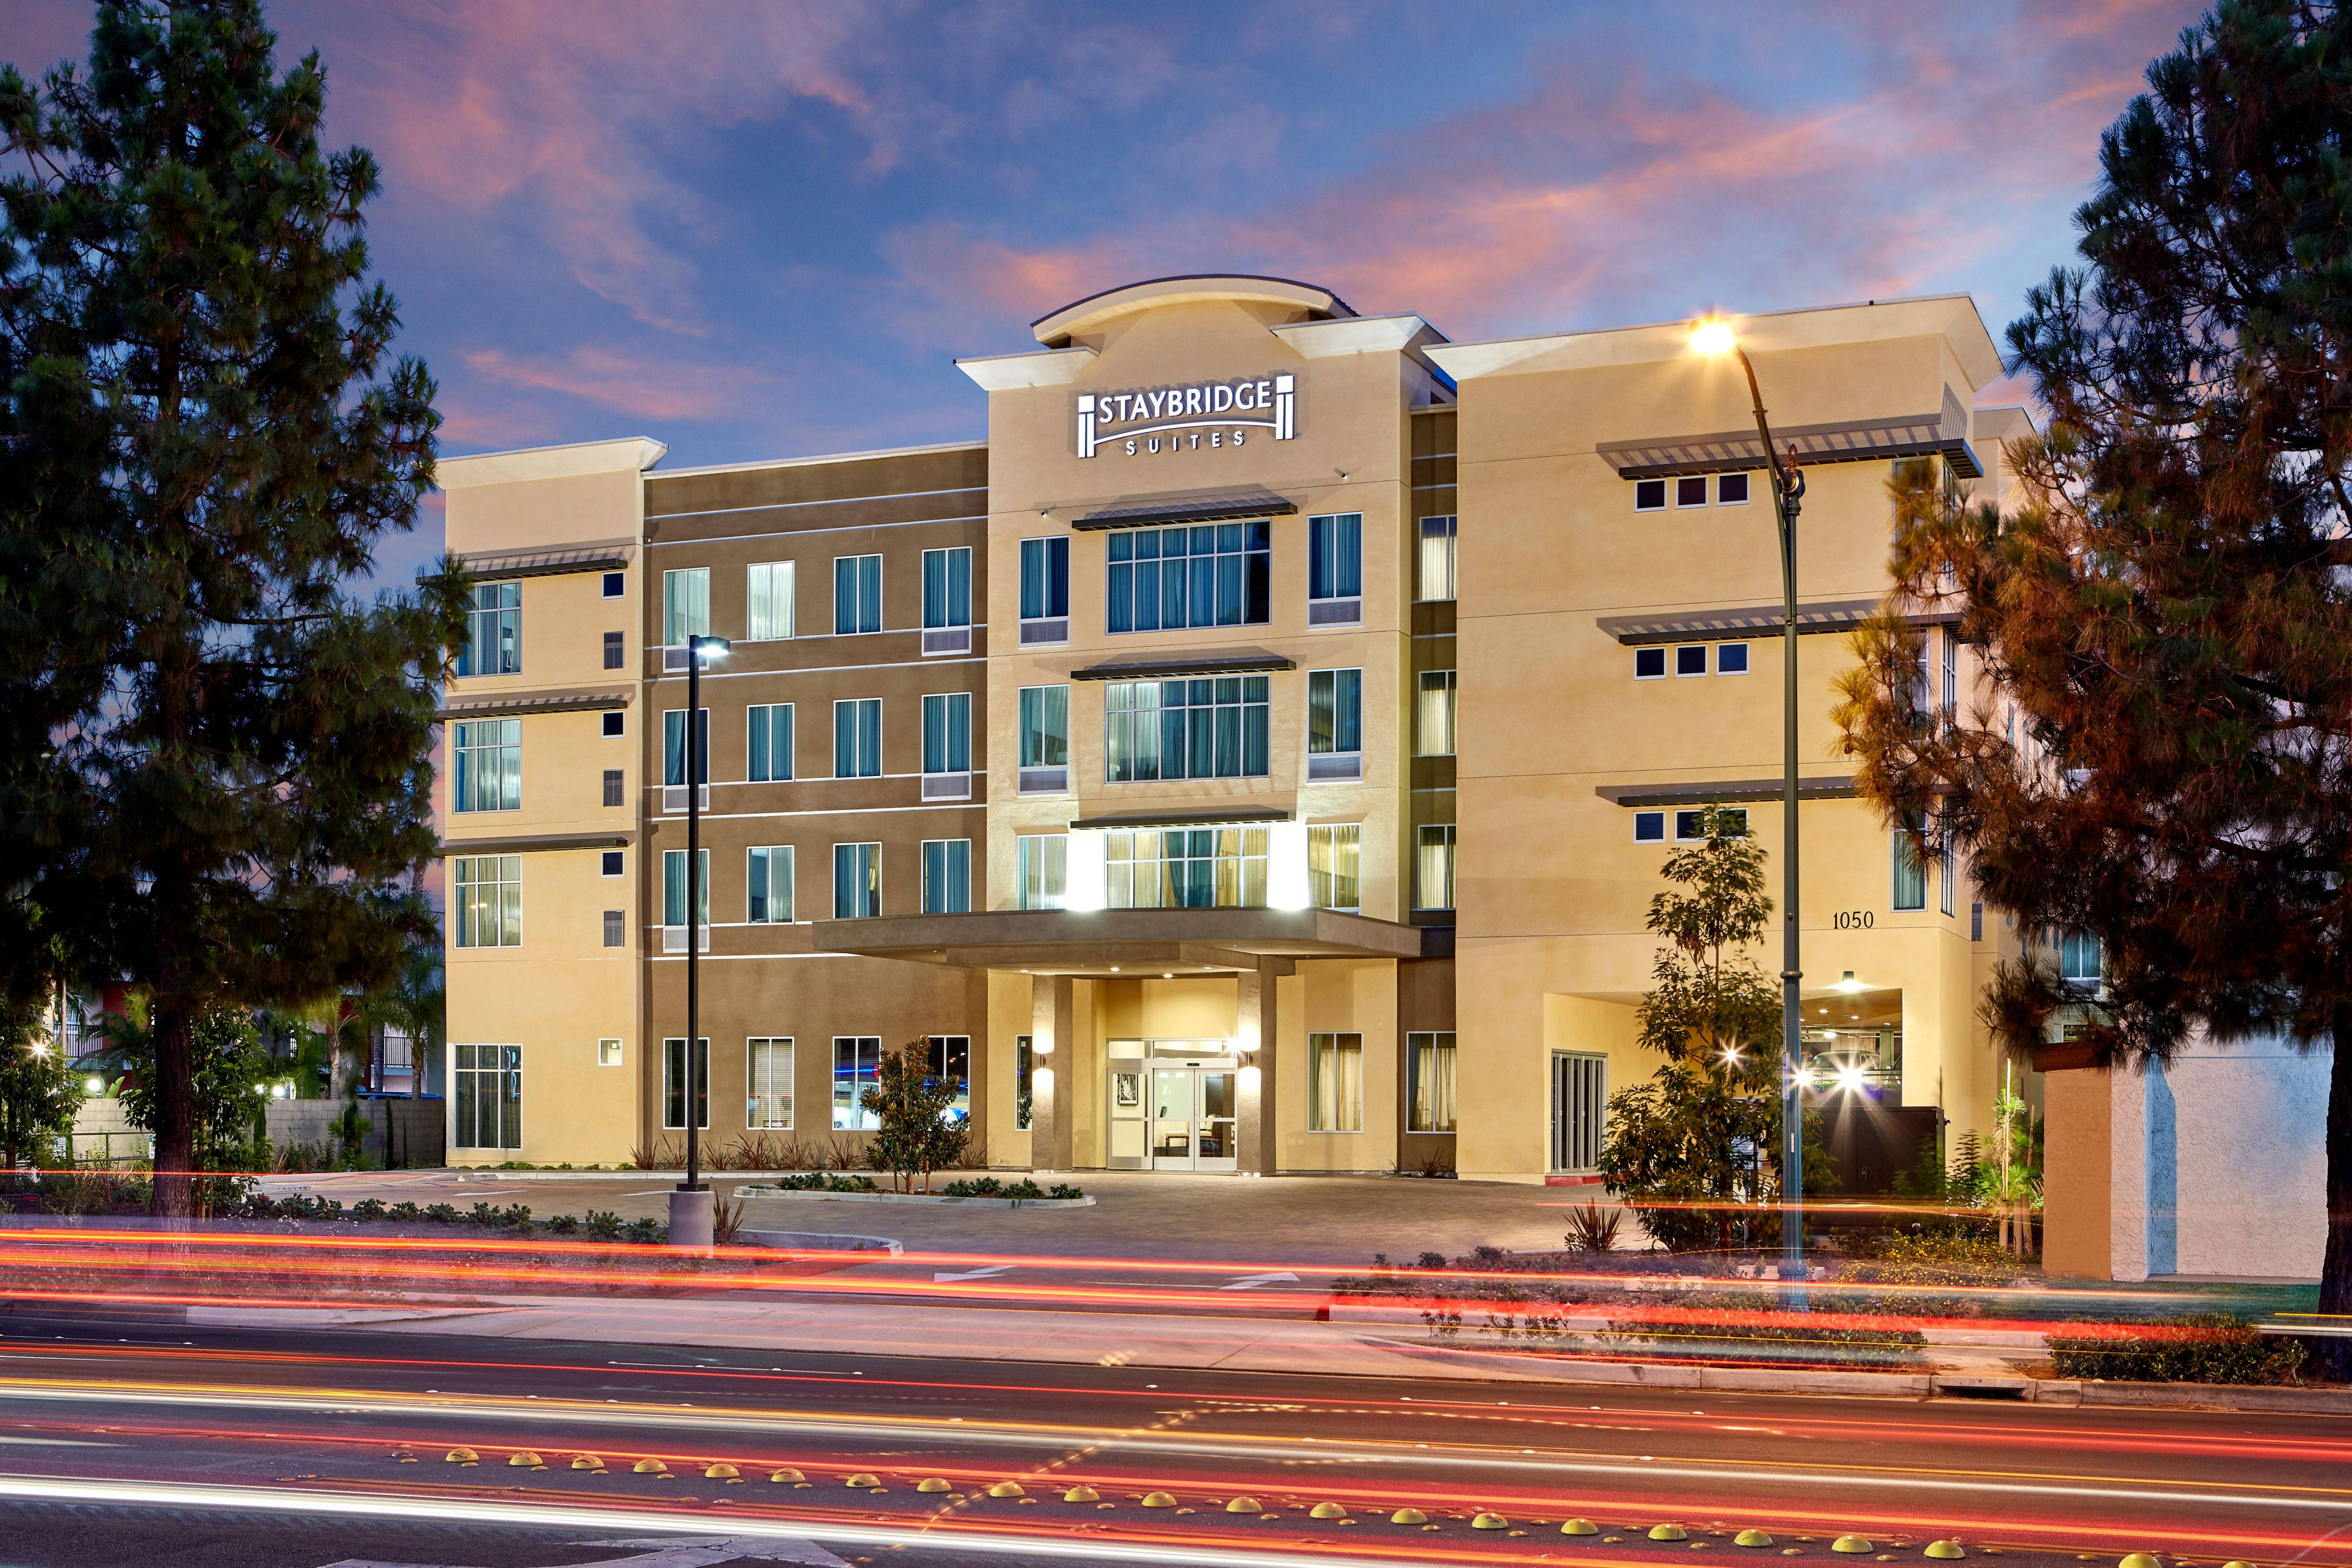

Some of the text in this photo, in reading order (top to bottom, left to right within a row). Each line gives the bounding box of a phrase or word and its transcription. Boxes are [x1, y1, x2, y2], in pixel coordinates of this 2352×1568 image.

[1098, 381, 1272, 424] STAYBRIDGE
[1125, 430, 1244, 456] SUITES
[1833, 911, 1874, 929] 1050
